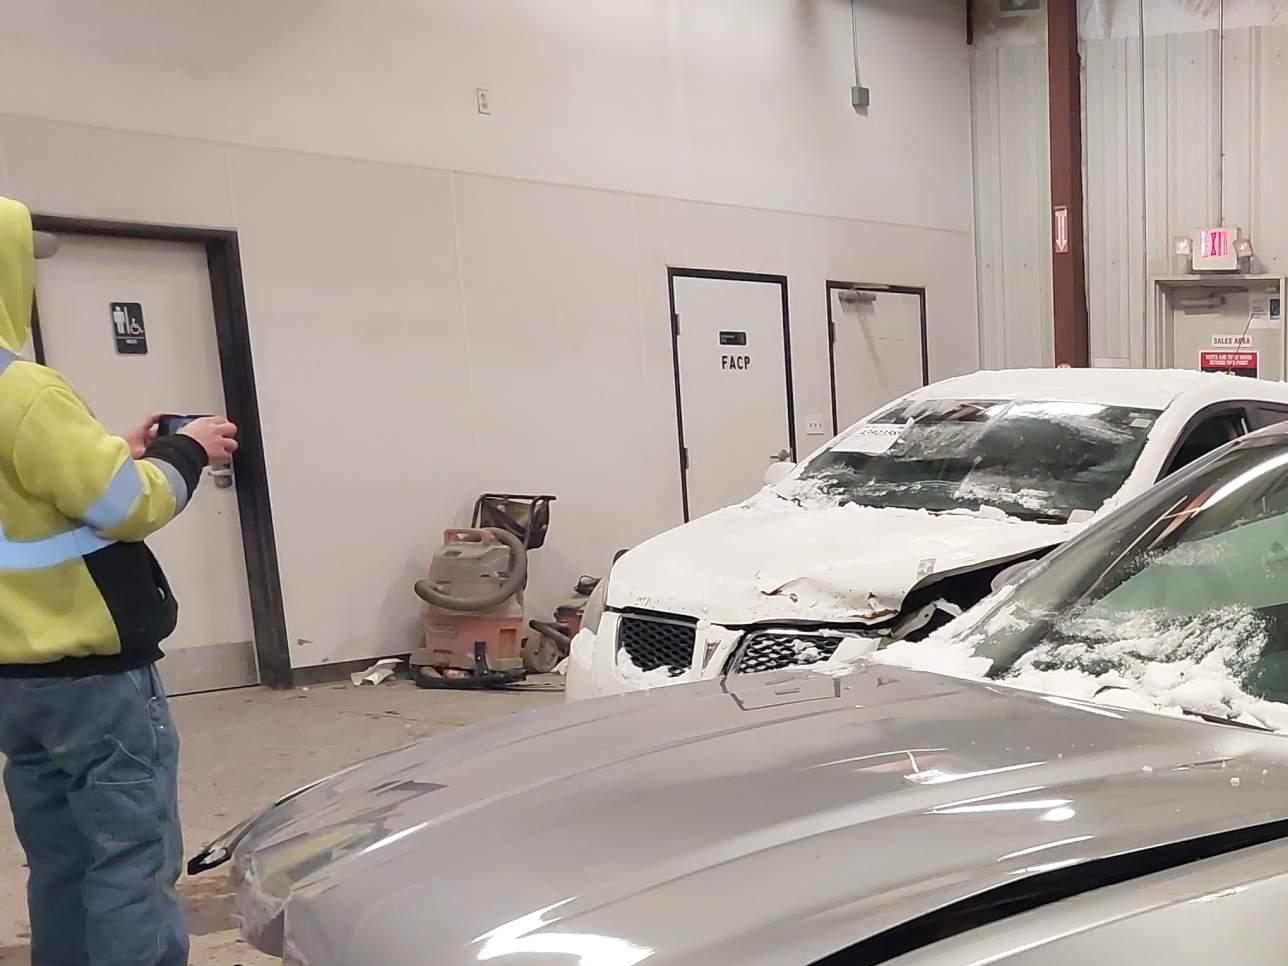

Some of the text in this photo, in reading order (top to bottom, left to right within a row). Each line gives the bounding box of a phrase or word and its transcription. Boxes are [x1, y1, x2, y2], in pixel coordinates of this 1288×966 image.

[1201, 231, 1232, 257] EXIT
[1213, 337, 1233, 345] SALES
[721, 355, 751, 370] FACP
